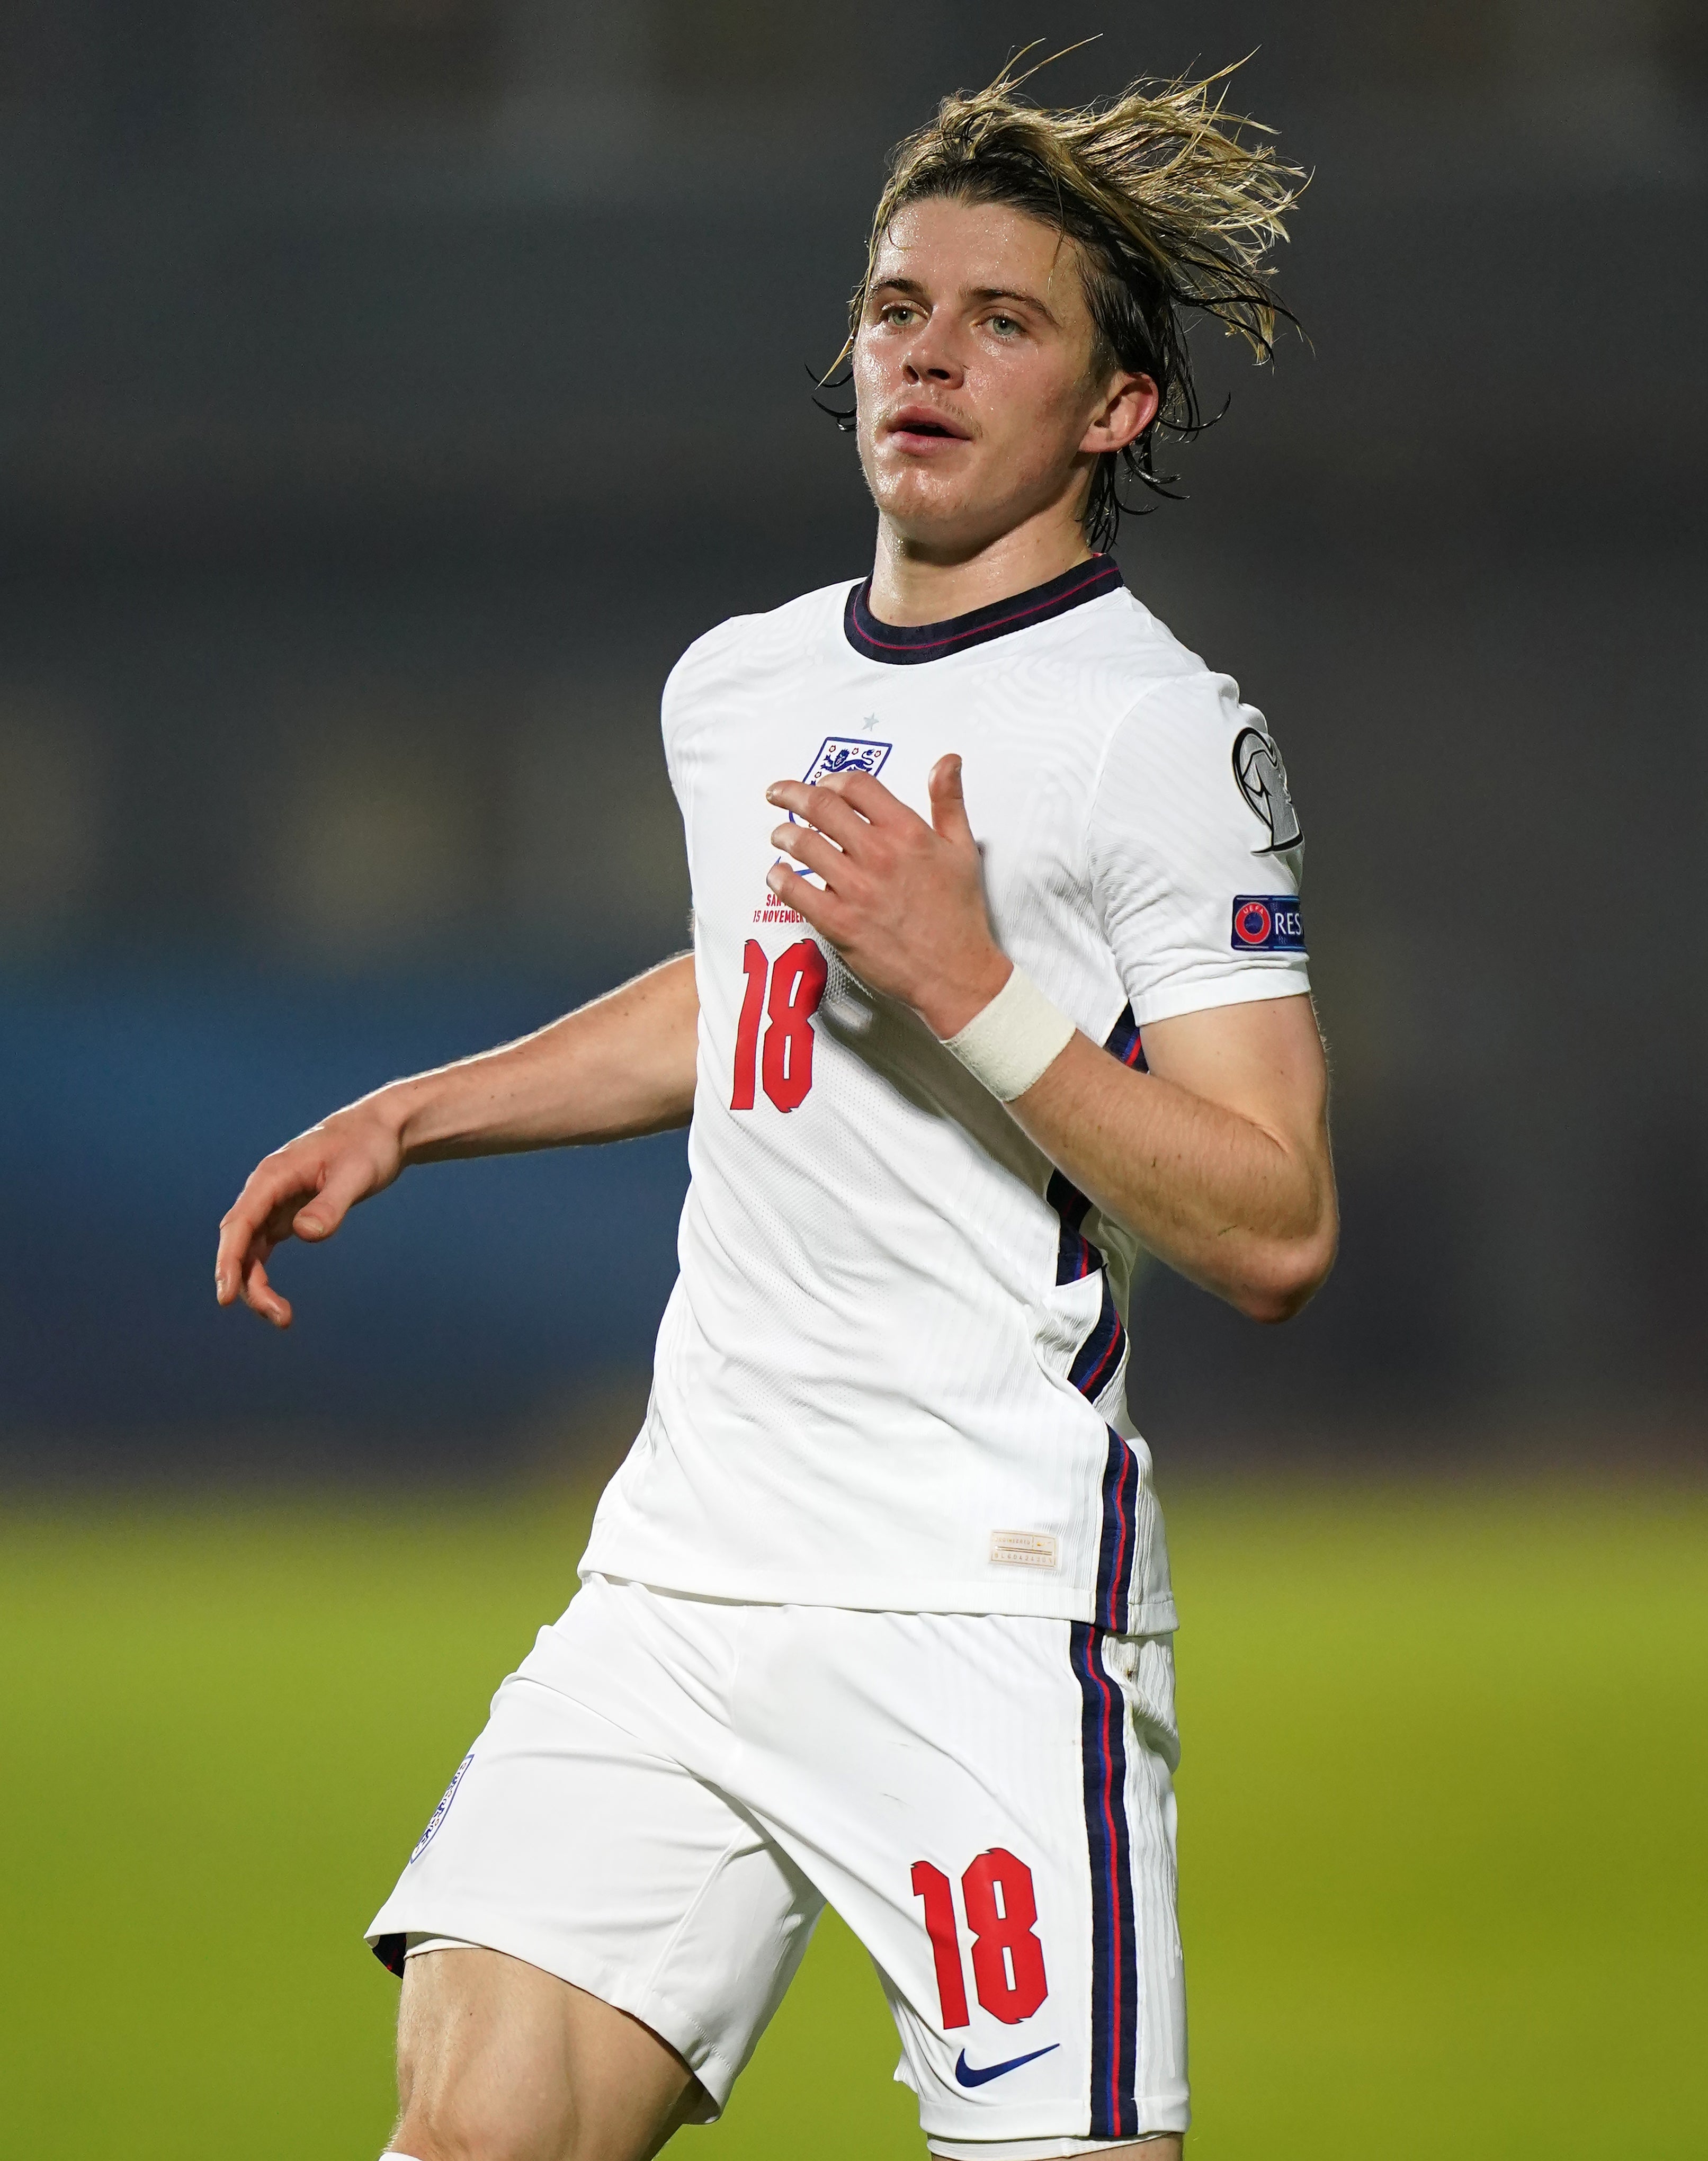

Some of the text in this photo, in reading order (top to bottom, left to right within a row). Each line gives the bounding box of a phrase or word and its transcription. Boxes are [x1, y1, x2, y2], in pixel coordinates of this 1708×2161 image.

[753, 910, 762, 923] 15
[1242, 905, 1264, 915] UEFA
[1275, 912, 1303, 936] RES
[729, 938, 828, 1114] 18
[910, 1847, 1049, 2030] 18
